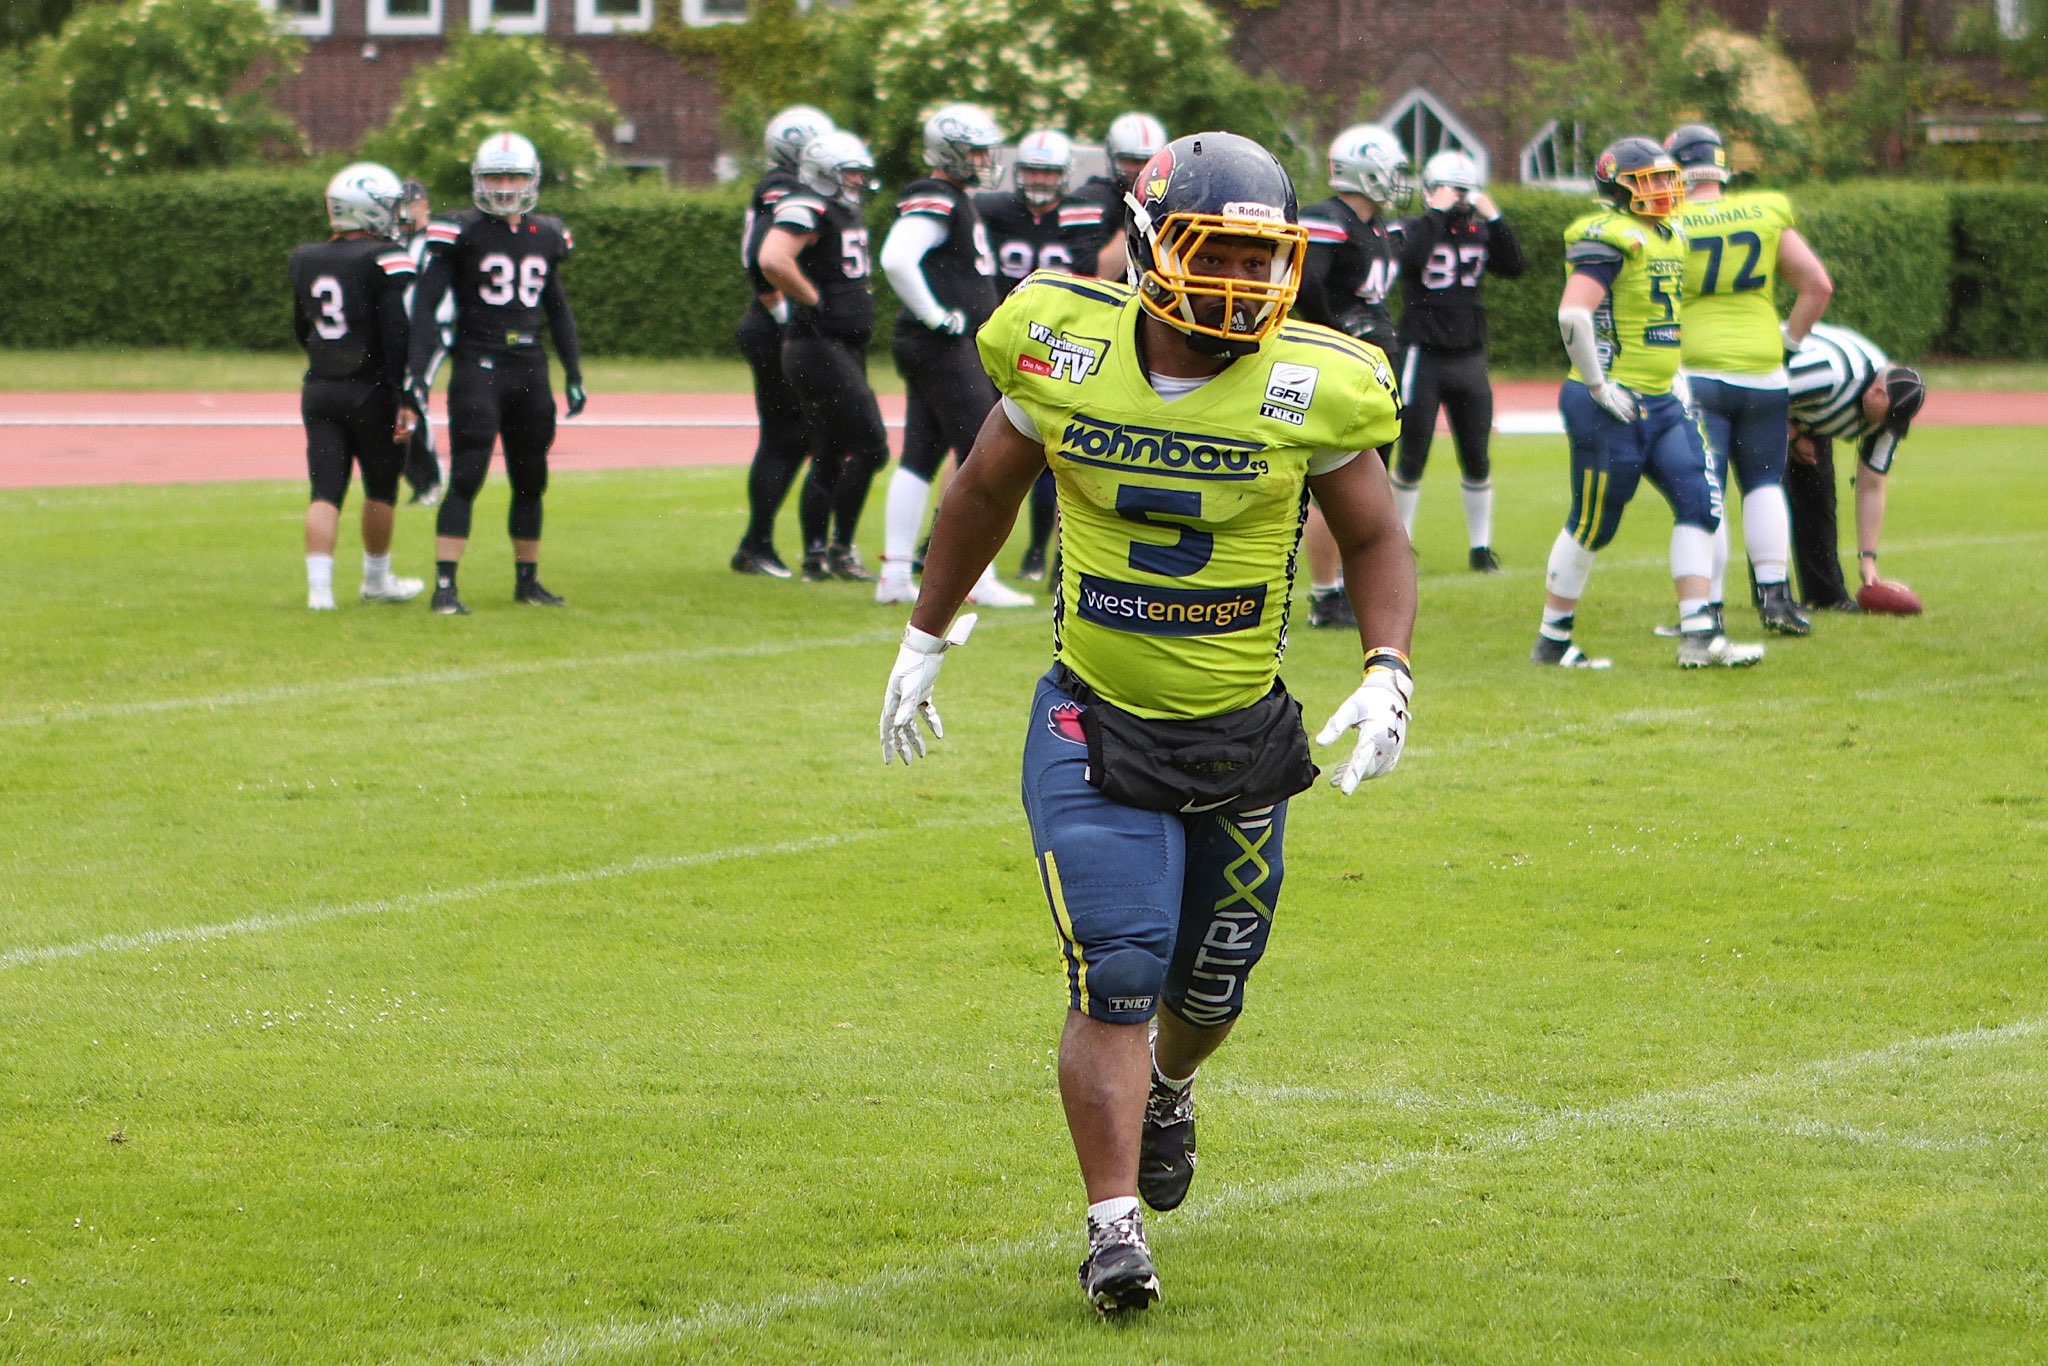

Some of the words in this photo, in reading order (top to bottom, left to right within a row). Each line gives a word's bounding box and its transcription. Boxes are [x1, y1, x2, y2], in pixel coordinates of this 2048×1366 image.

[1238, 206, 1271, 219] Riddell
[1683, 205, 1762, 228] ARDINALS
[478, 253, 548, 308] 36
[1689, 231, 1766, 297] 72
[311, 276, 348, 340] 3
[1022, 360, 1034, 369] Die
[1034, 363, 1045, 373] Nr.
[1050, 348, 1095, 384] TV
[1262, 404, 1304, 425] TNKD
[1061, 422, 1250, 472] wohnbau
[1115, 483, 1214, 578] 5
[1084, 594, 1256, 627] westenergie
[1111, 998, 1151, 1011] TNKD
